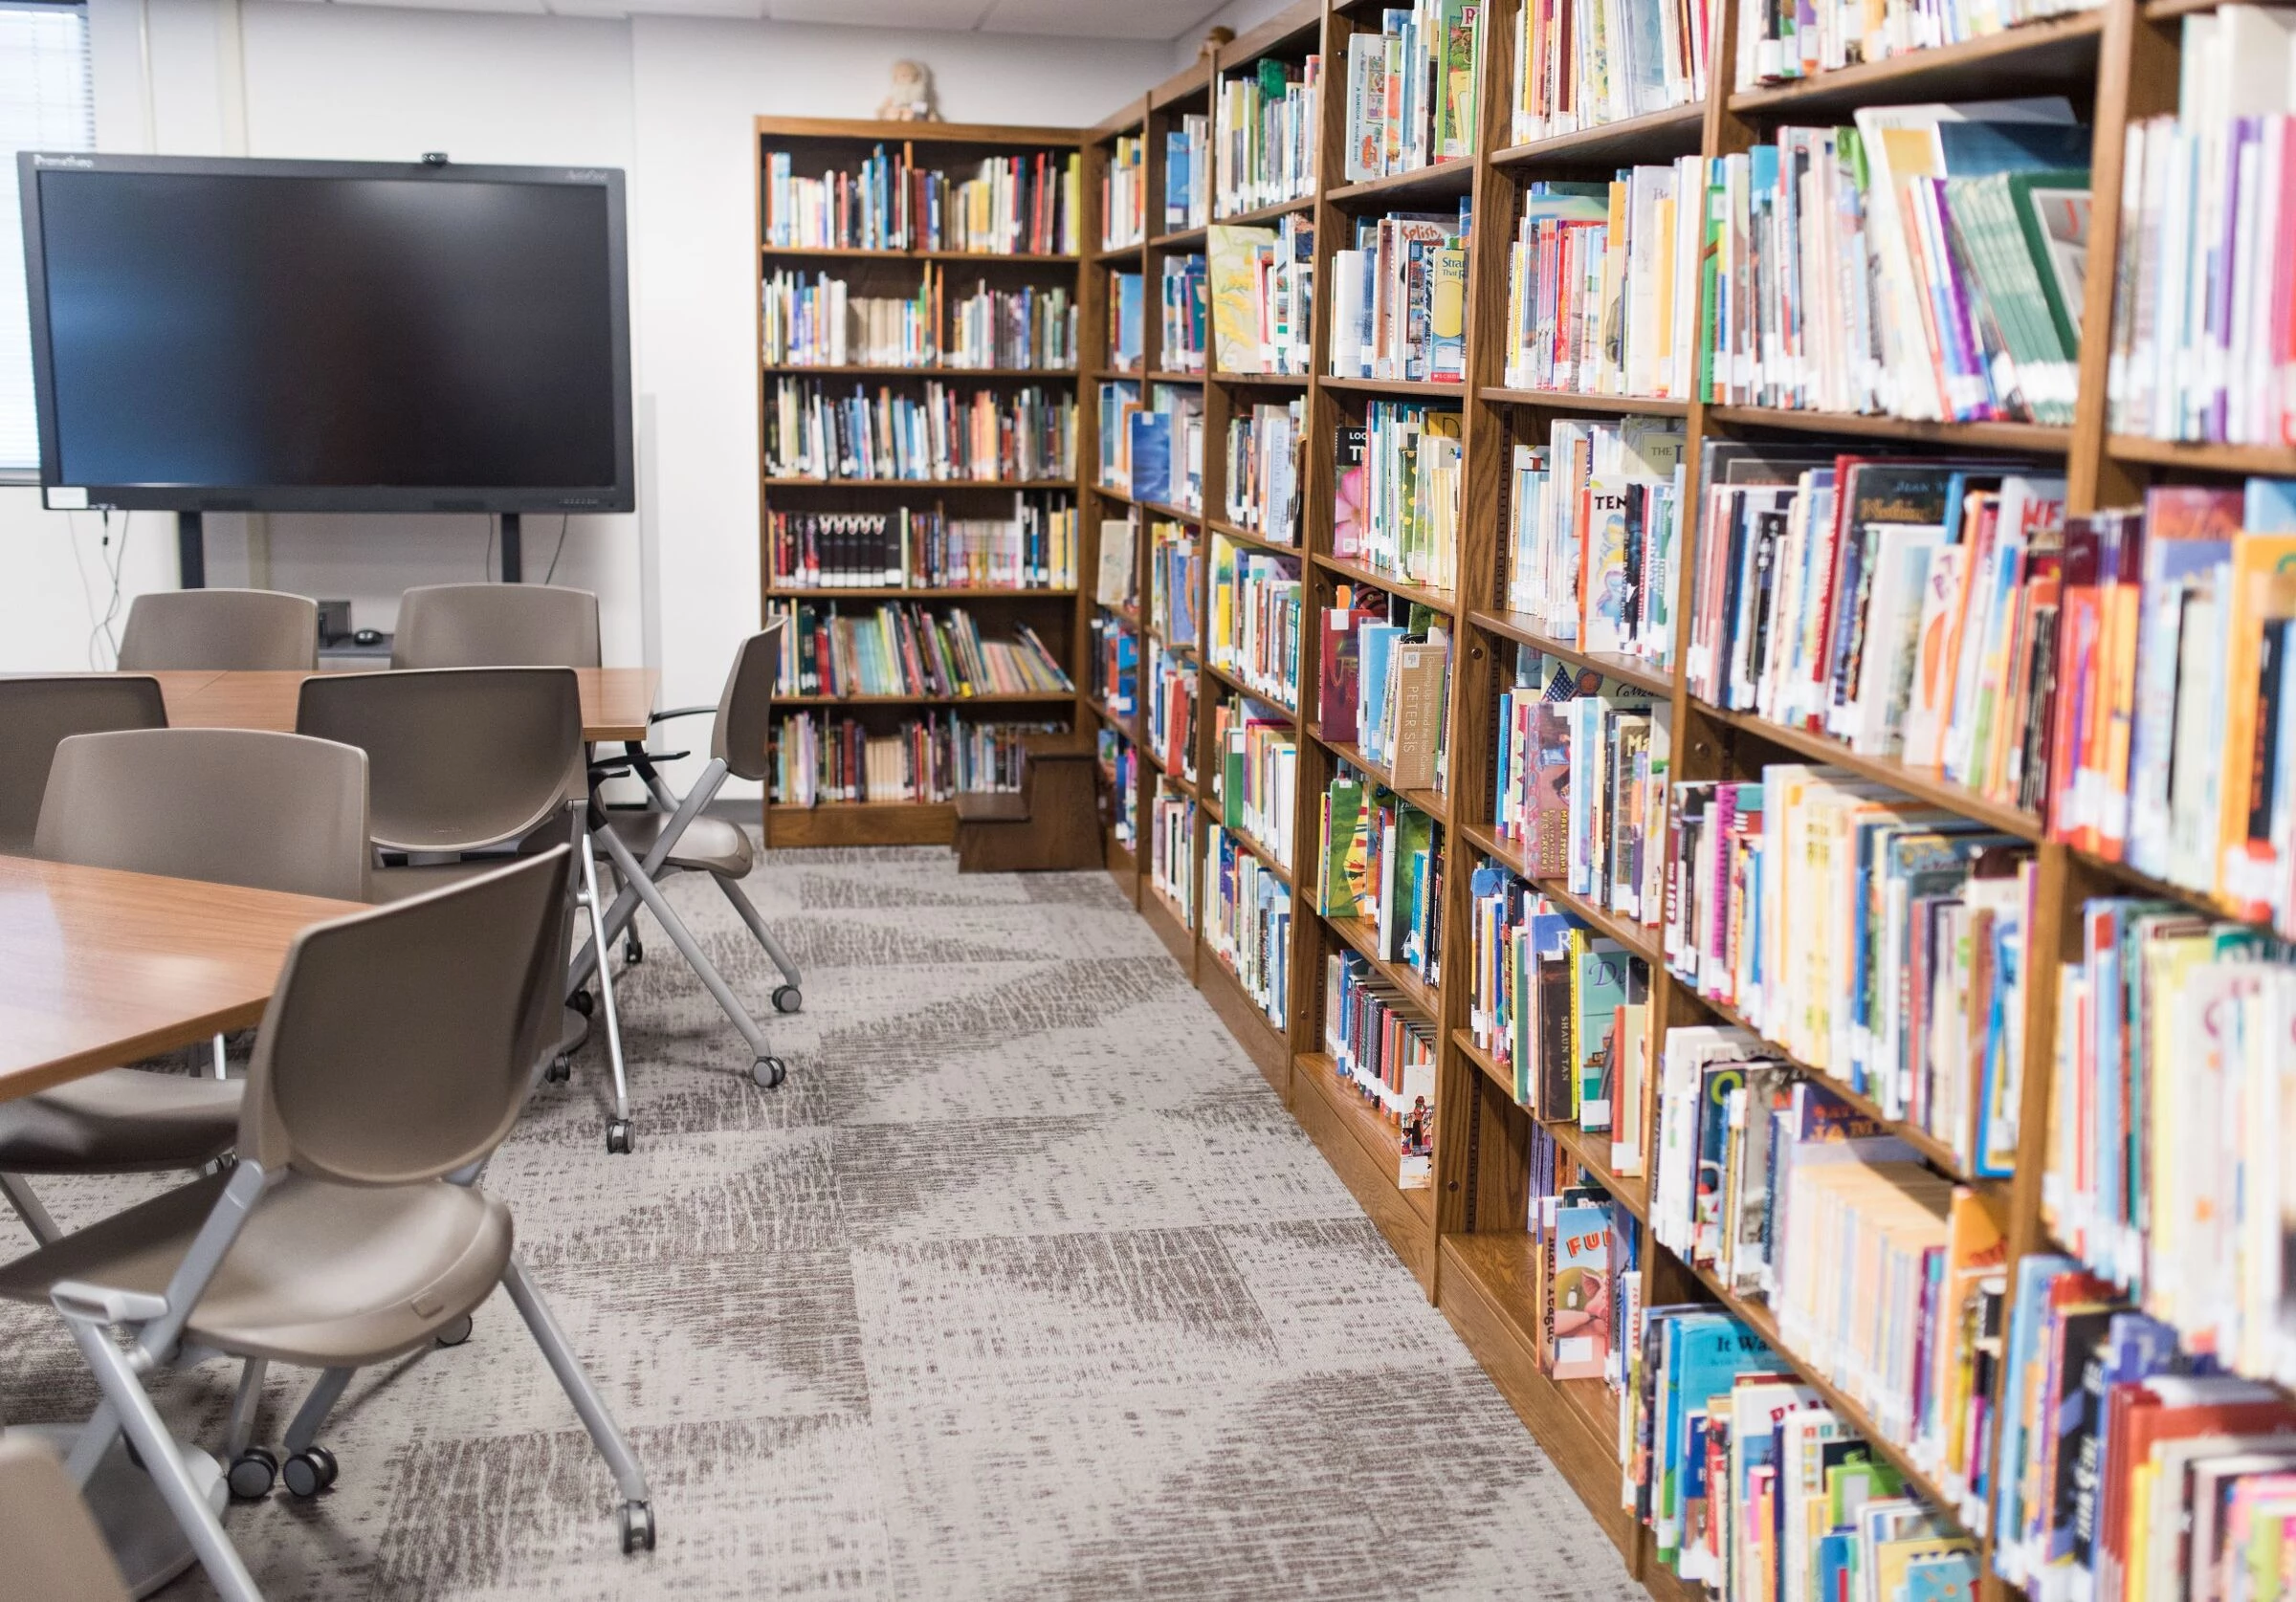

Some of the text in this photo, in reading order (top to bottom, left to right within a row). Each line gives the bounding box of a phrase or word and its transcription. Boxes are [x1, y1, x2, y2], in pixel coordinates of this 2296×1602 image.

[1594, 495, 1627, 511] TEN
[1405, 685, 1420, 727] PETER
[1560, 1057, 1569, 1082] TAN
[1716, 1334, 1732, 1352] It
